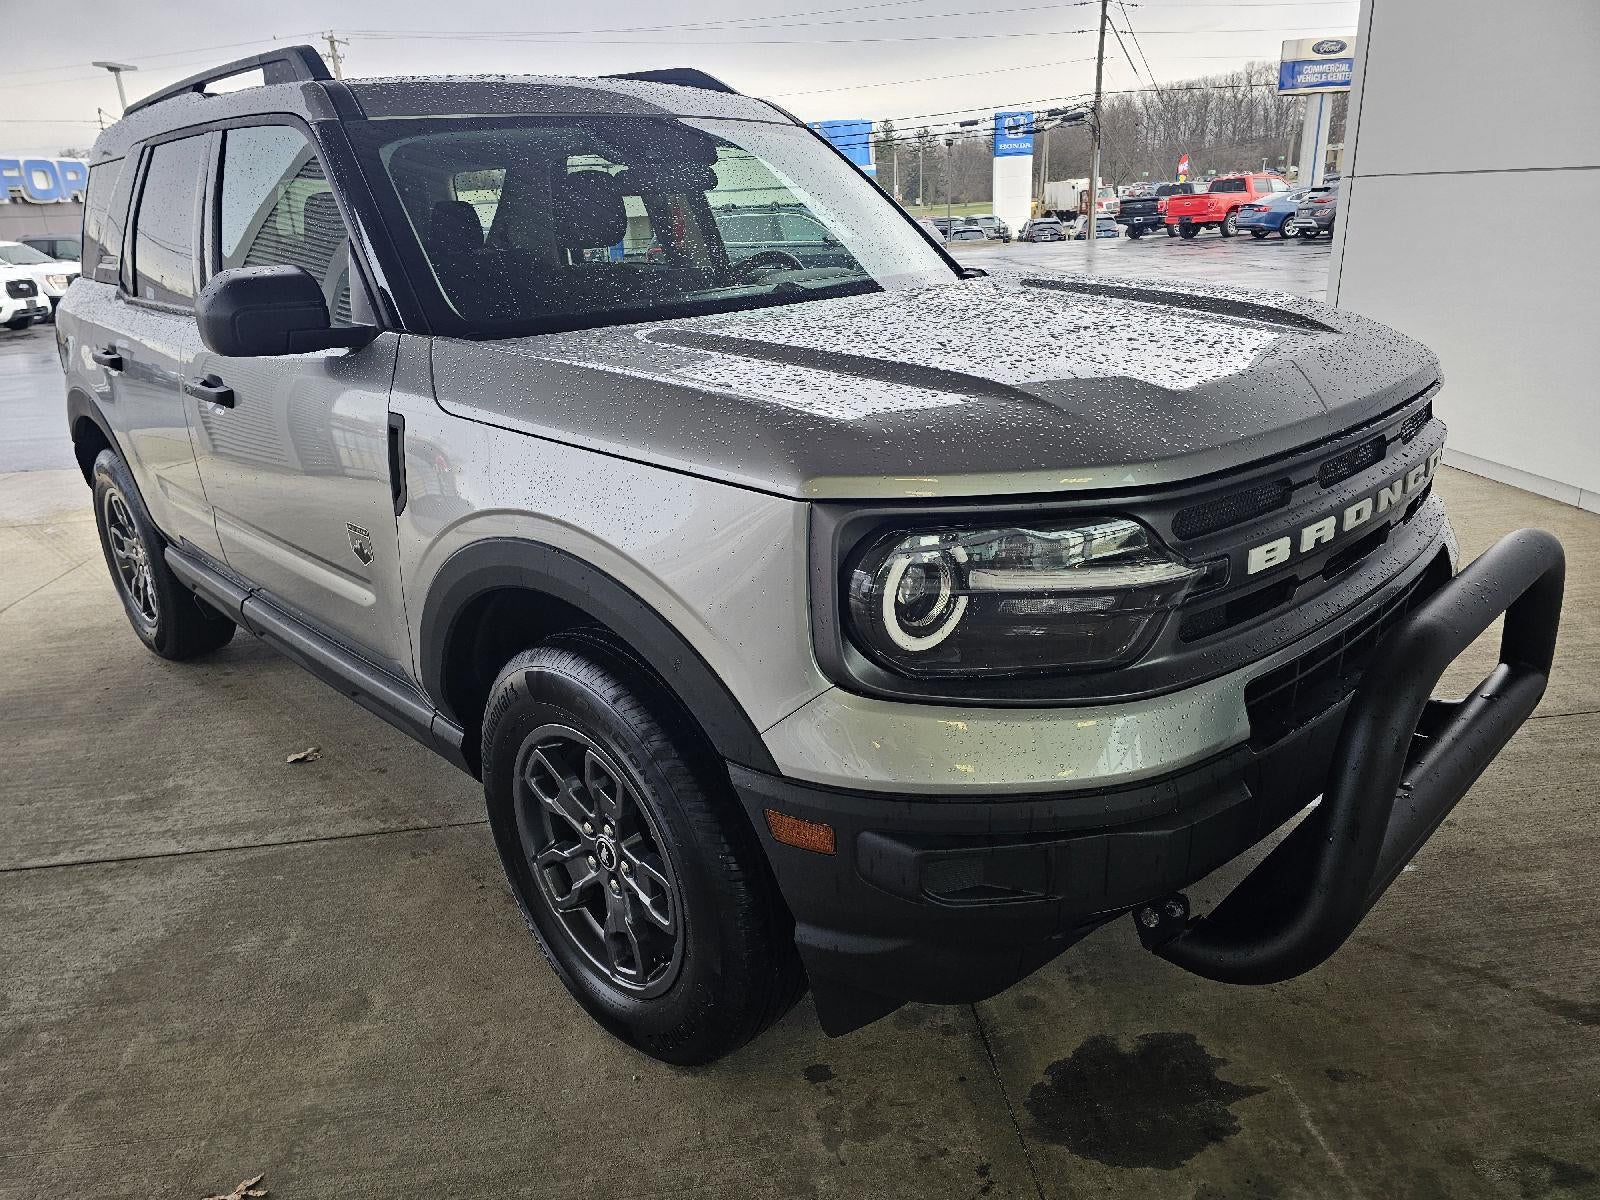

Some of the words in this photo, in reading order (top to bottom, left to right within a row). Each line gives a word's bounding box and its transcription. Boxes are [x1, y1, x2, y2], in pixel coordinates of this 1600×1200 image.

[1319, 41, 1341, 53] Ford
[1303, 63, 1351, 74] COMMERCIAL
[1297, 73, 1327, 83] VEHICLE
[999, 142, 1033, 150] HONDA
